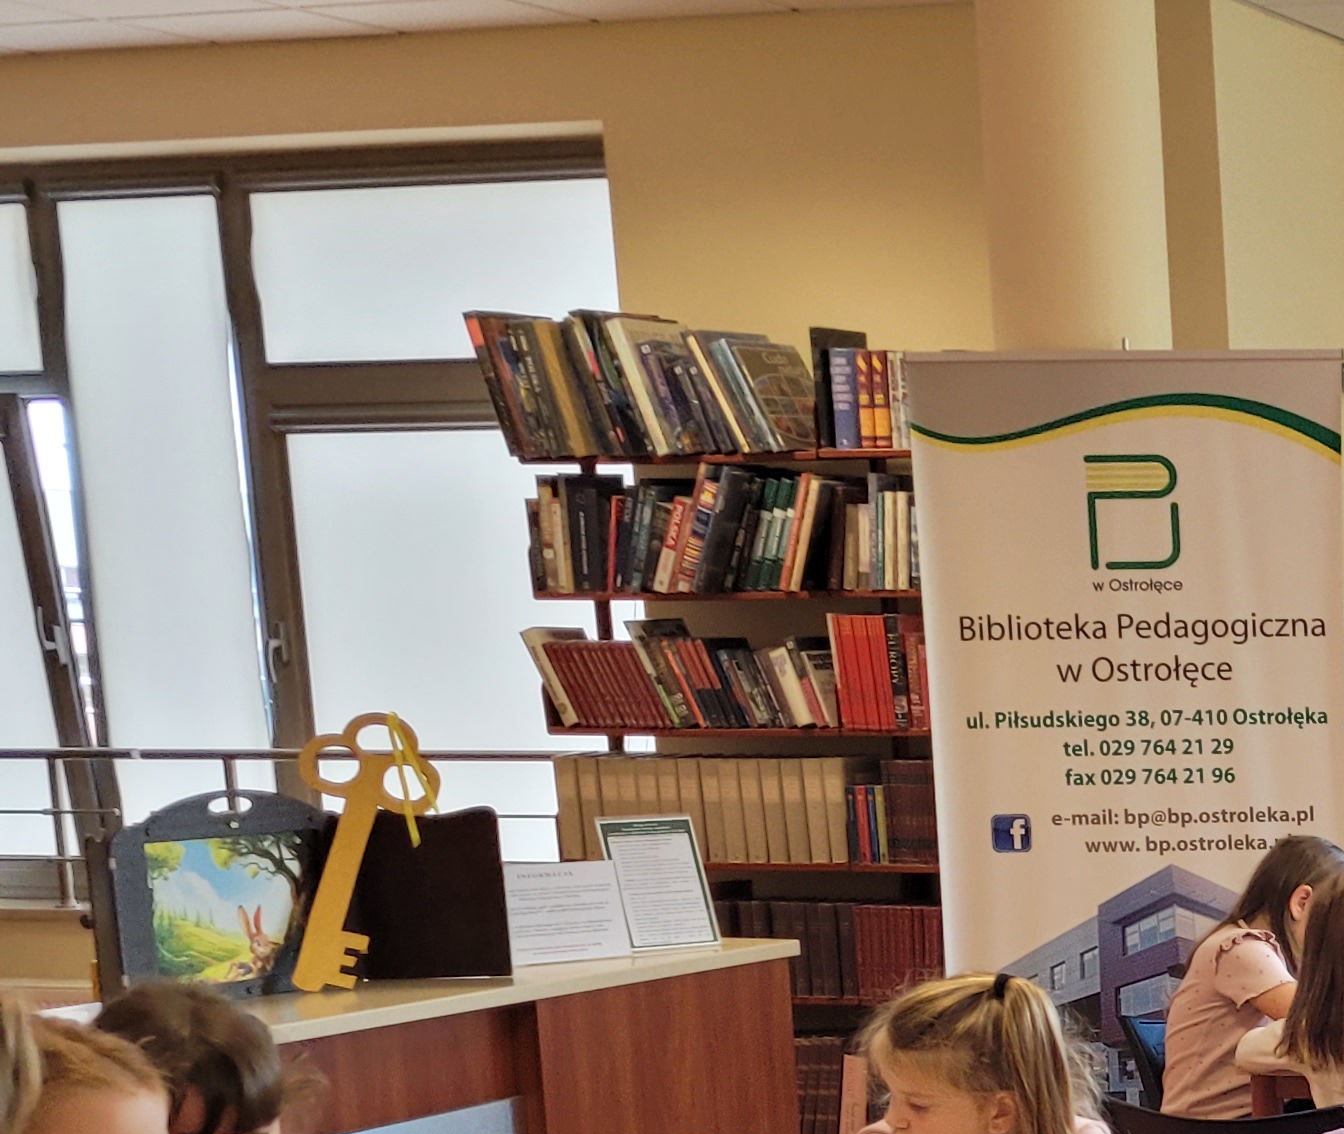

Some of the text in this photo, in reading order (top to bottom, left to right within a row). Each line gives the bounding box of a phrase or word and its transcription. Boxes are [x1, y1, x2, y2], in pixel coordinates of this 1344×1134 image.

[1092, 577, 1183, 593] w Ostrołęce
[959, 612, 1327, 645] Biblioteka Pedagogiczna
[1056, 655, 1233, 688] w Ostrołęce
[966, 706, 1328, 732] ul. Piłsudskiego 38, 07-410 Ostrołęka
[1063, 738, 1234, 757] tel. 029 764 21 29
[1065, 767, 1236, 786] fax 029 764 21 96
[1051, 805, 1315, 829] e-mail: bp@bp.ostroleka.pl
[1085, 834, 1291, 855] www. bp.ostroleka.
